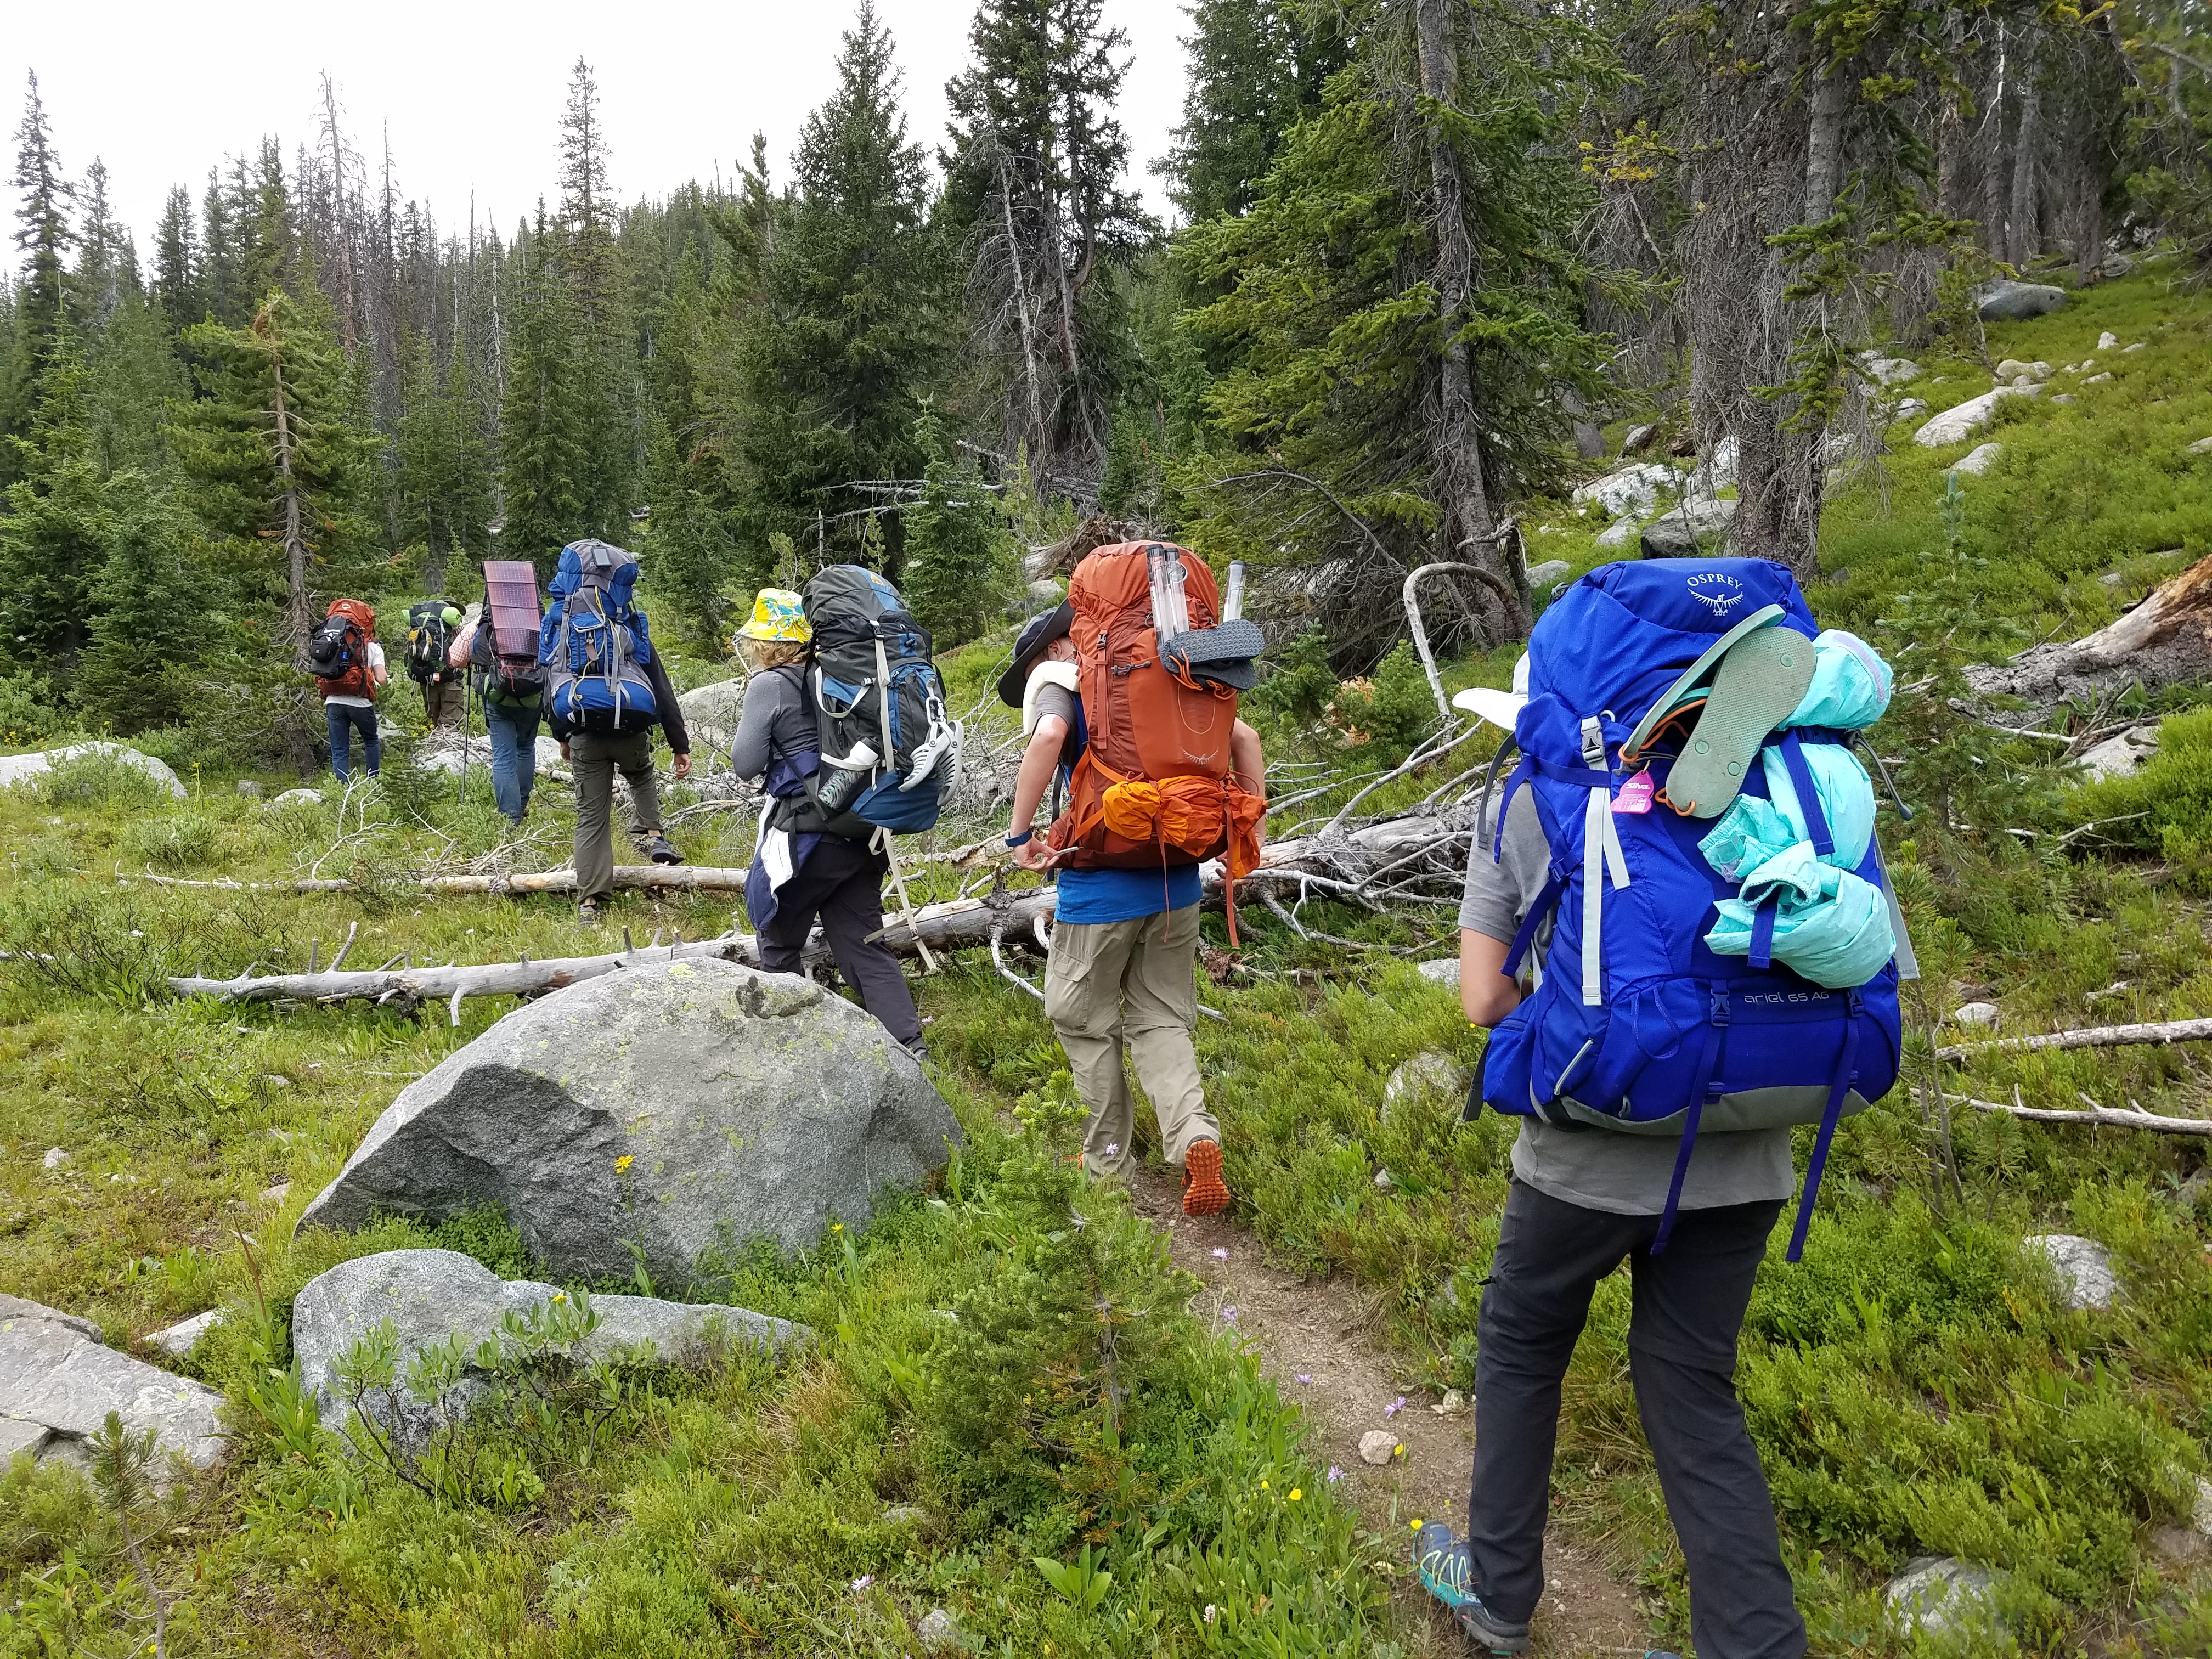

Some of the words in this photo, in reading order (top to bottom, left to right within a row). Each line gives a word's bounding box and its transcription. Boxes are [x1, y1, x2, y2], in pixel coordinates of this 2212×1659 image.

[1687, 573, 1743, 590] OSPREY
[1744, 992, 1785, 1003] ariel
[1787, 992, 1808, 1002] 65
[1812, 991, 1829, 1001] AG
